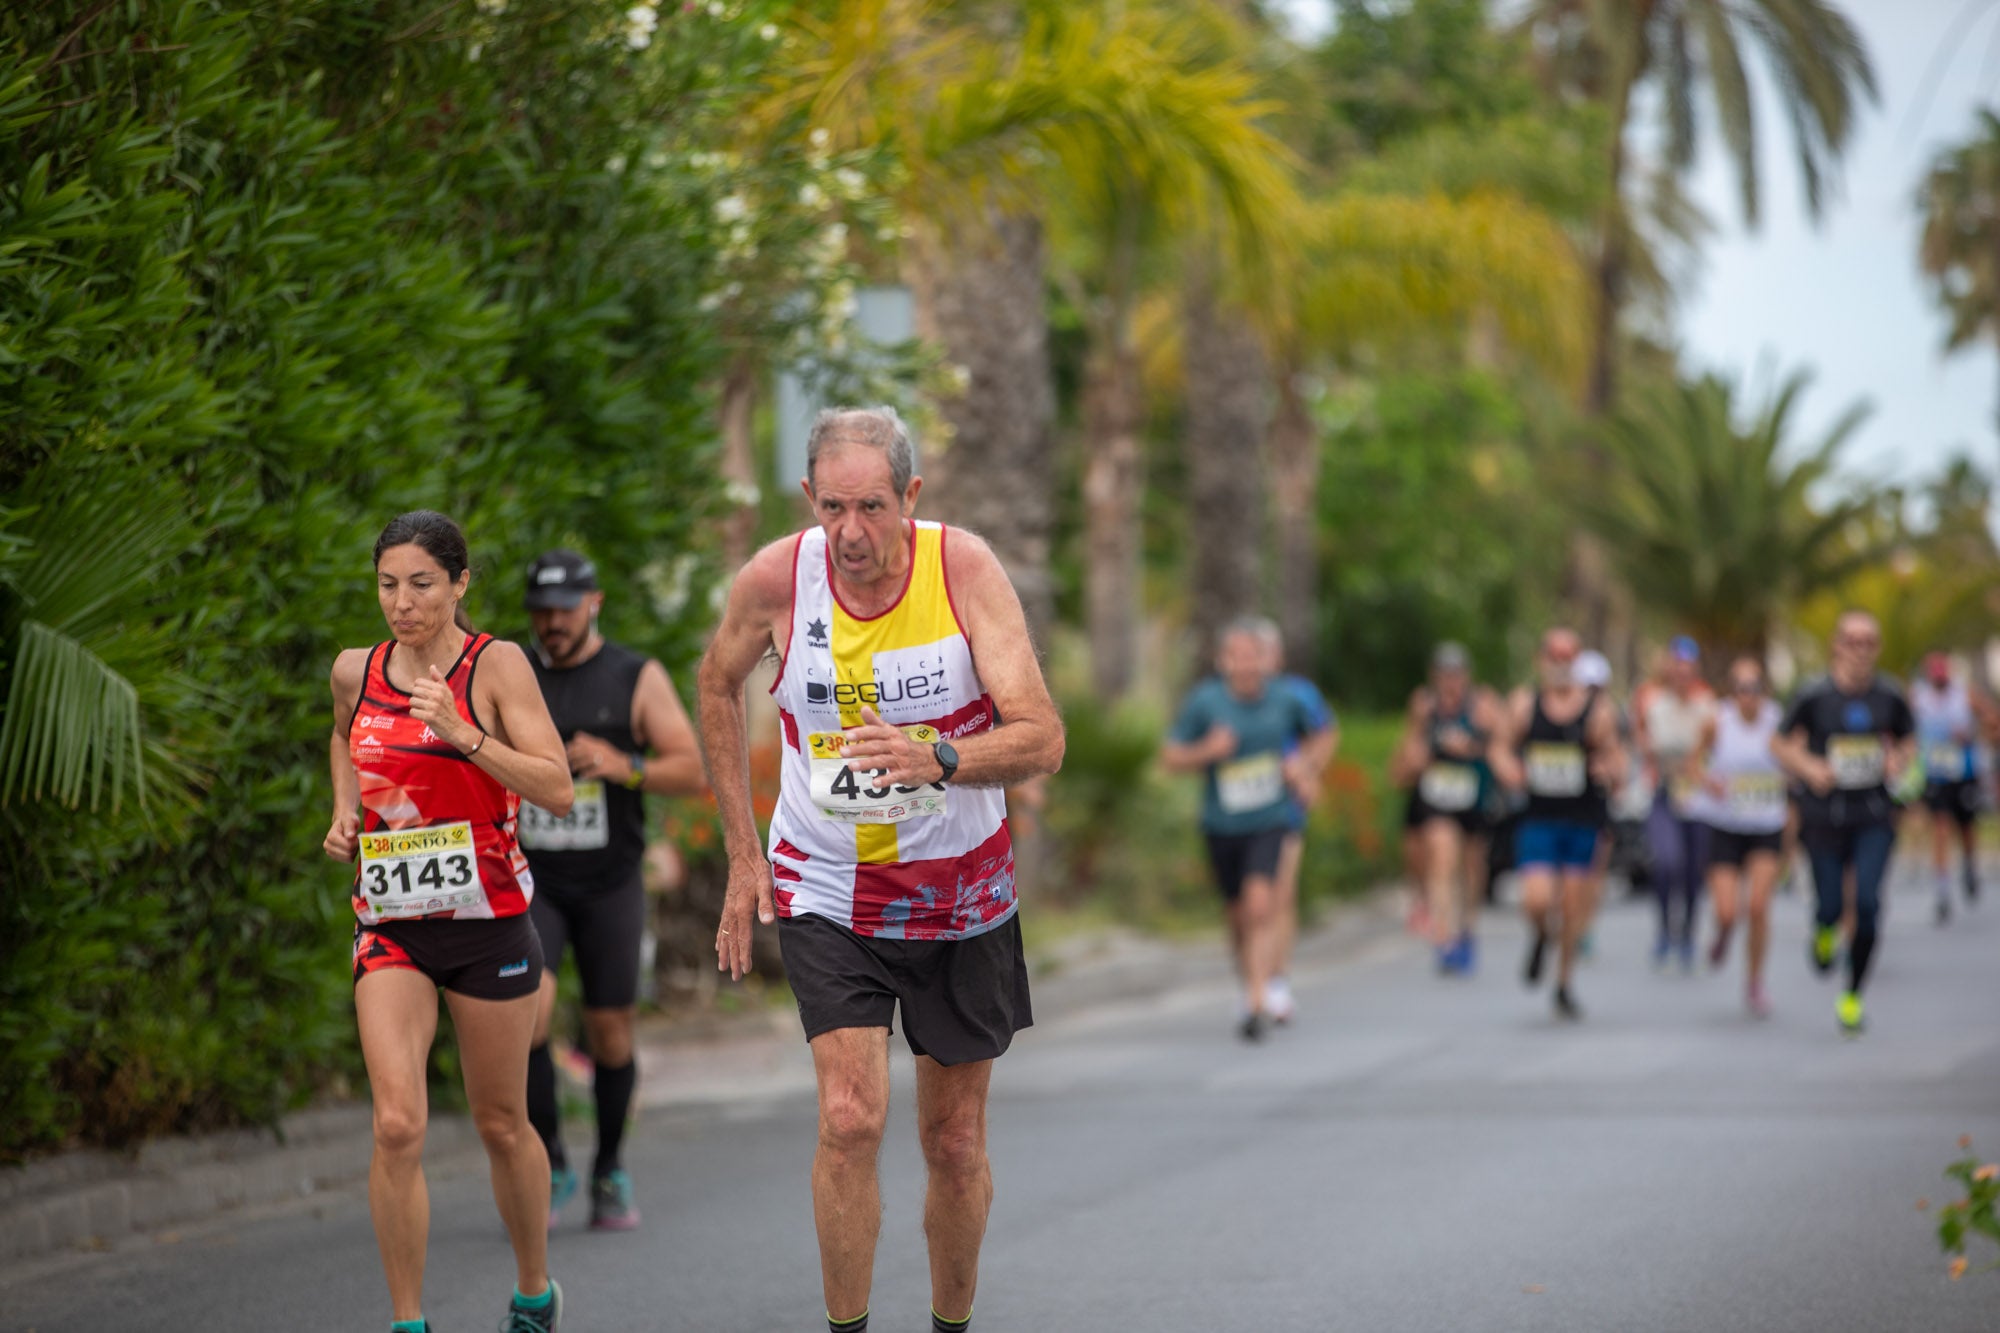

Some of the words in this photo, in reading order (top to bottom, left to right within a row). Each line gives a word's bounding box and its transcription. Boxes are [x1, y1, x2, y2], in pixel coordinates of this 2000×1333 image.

[830, 764, 946, 800] 43
[374, 838, 390, 853] 38
[390, 836, 448, 852] FONDO
[366, 854, 473, 897] 3143
